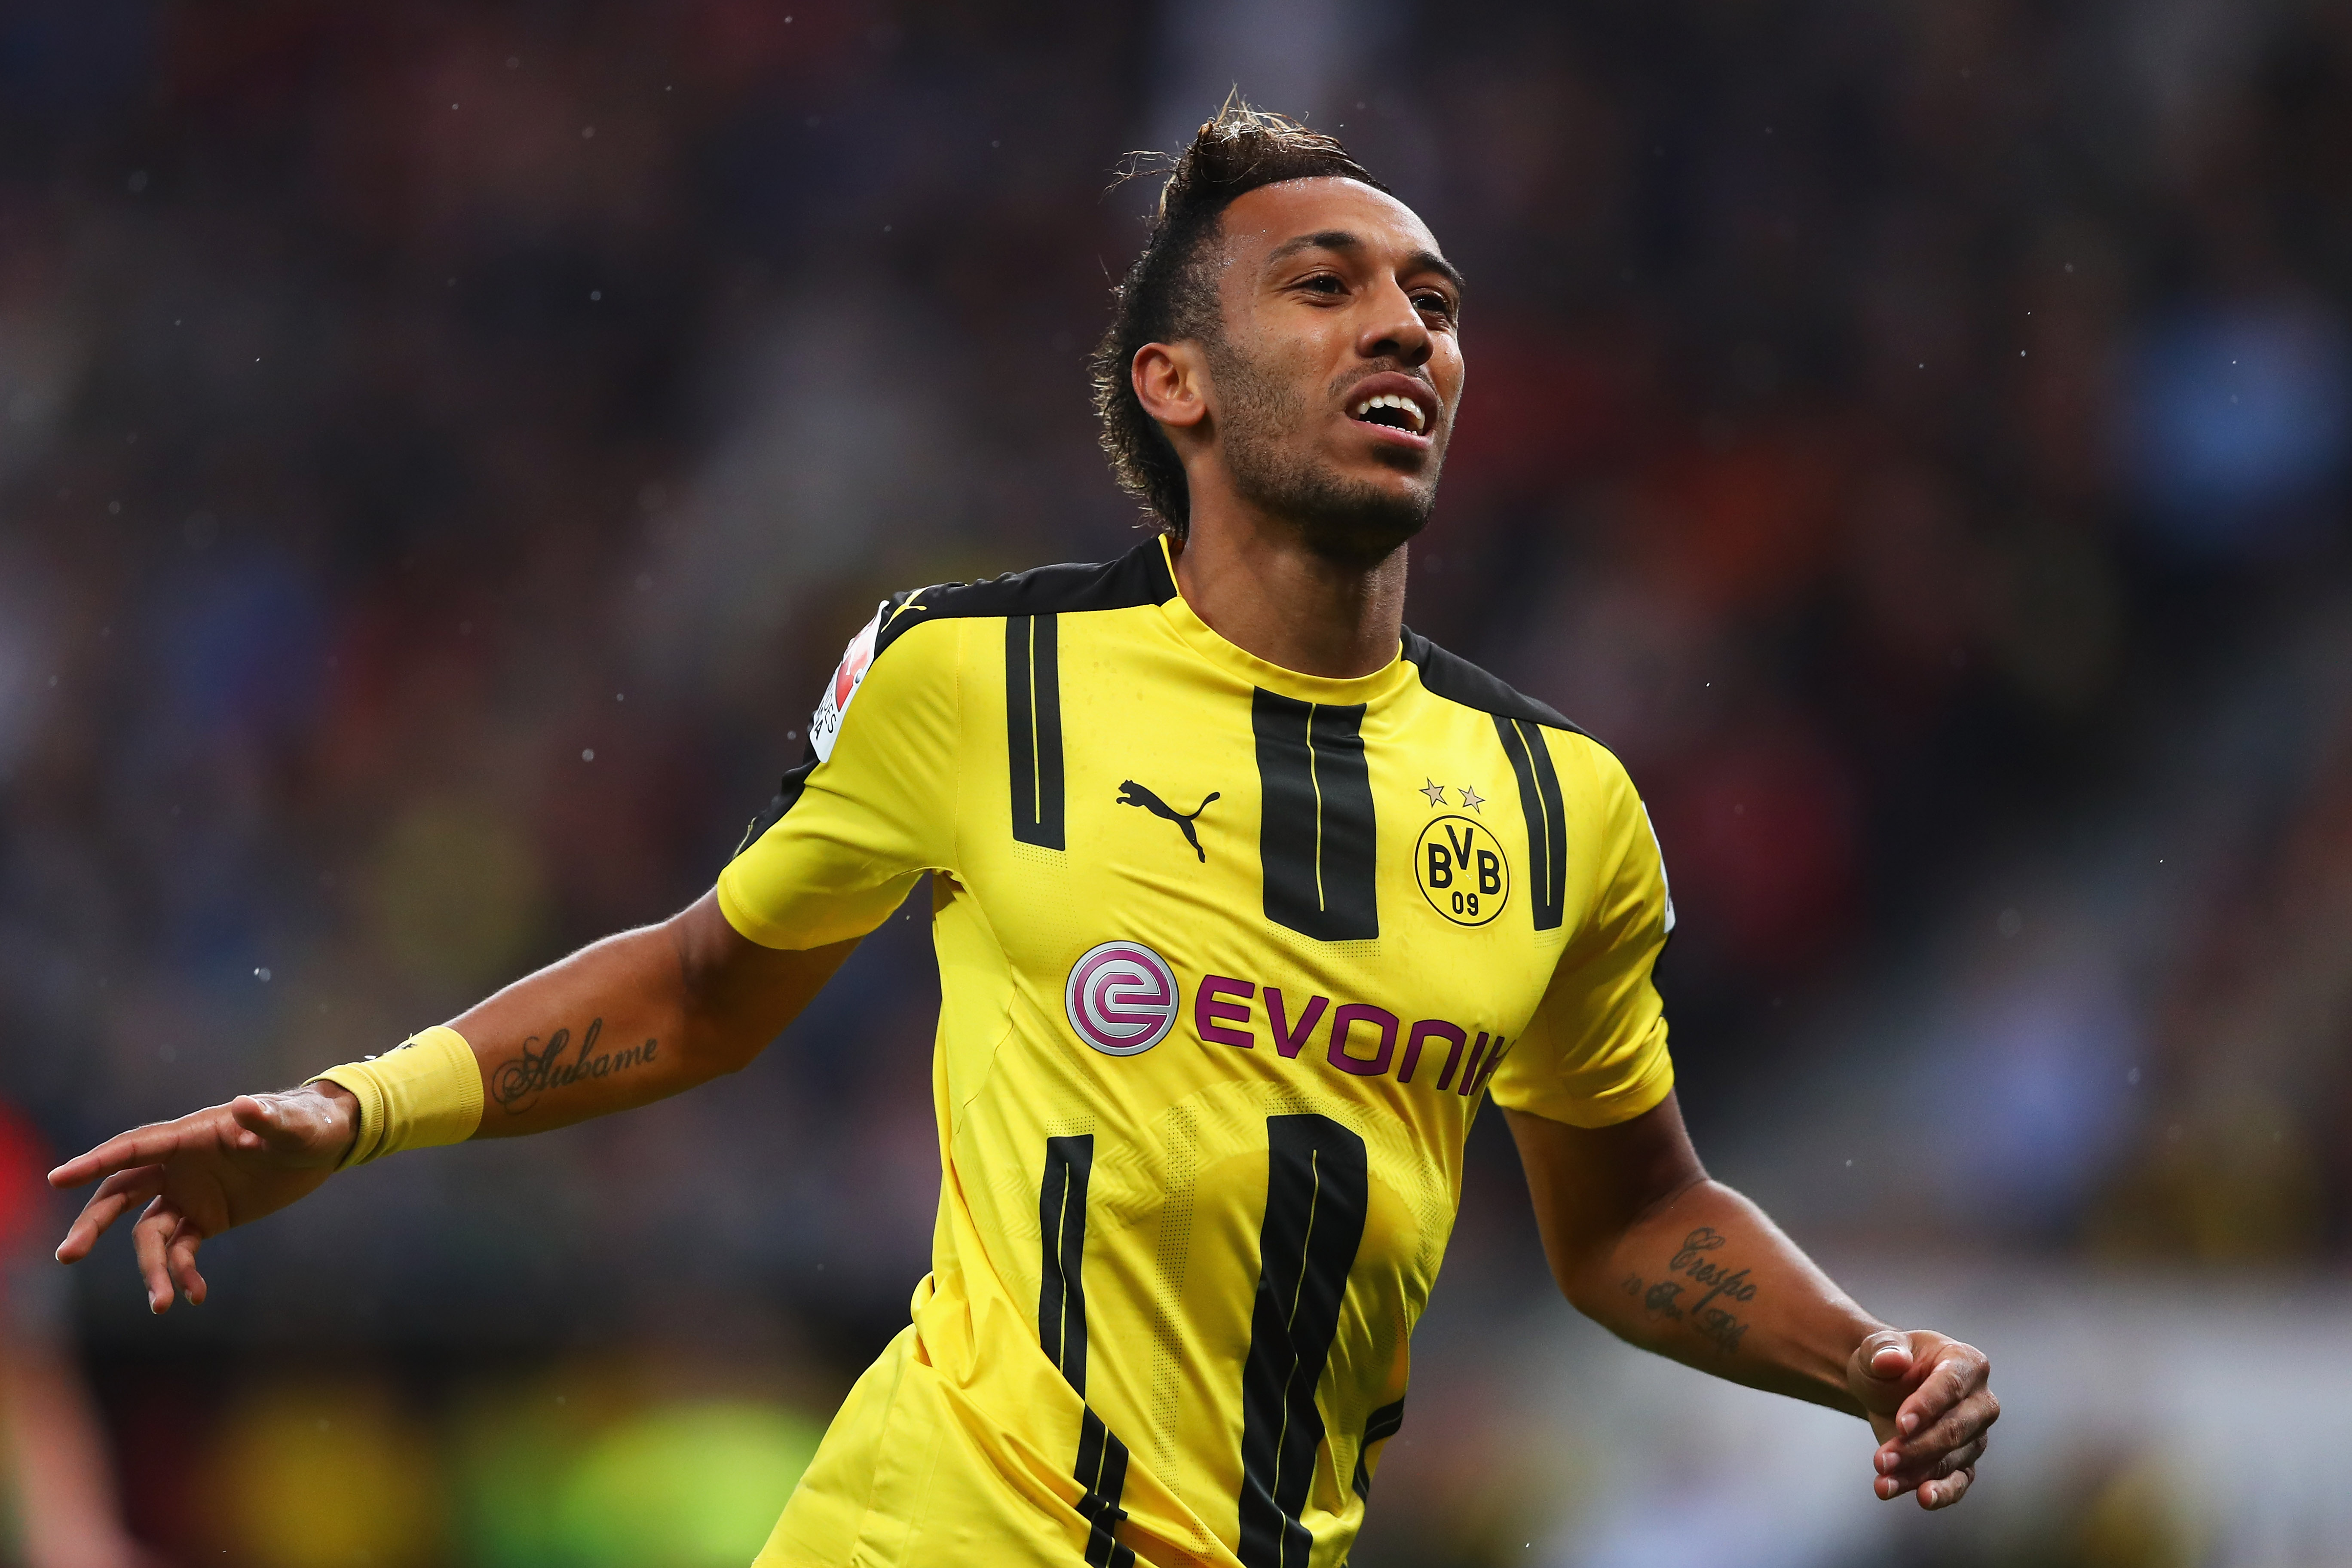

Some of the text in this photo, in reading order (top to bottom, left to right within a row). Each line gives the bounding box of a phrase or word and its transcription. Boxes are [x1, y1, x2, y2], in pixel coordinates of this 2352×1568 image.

[1427, 824, 1501, 895] BVB
[1452, 891, 1479, 916] 09
[491, 1017, 658, 1115] Aubame
